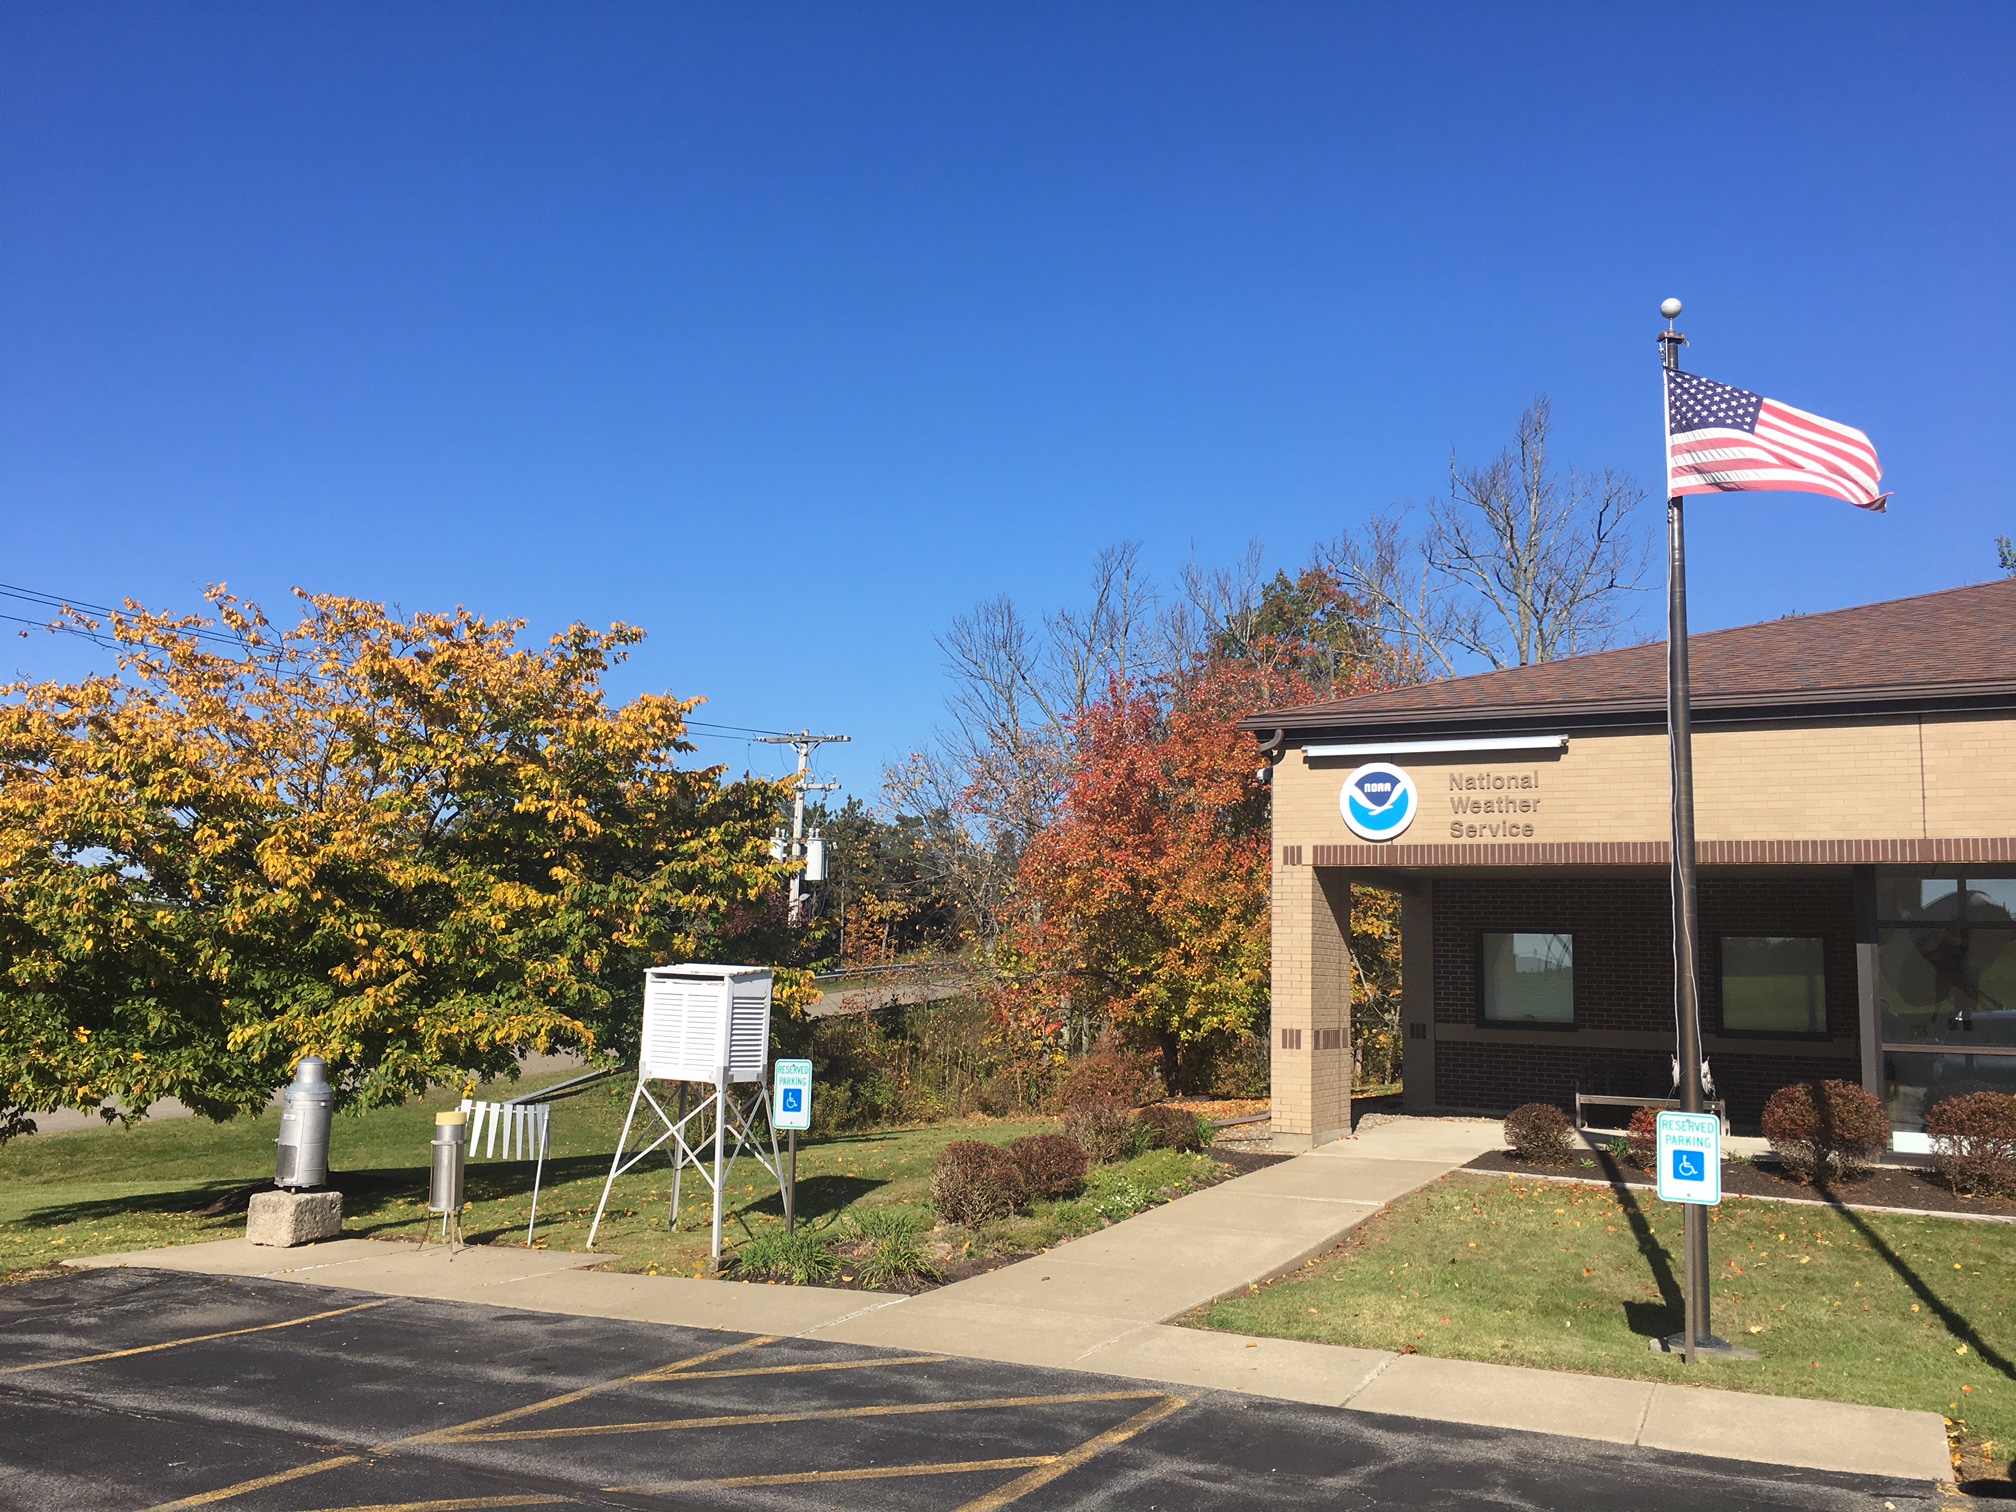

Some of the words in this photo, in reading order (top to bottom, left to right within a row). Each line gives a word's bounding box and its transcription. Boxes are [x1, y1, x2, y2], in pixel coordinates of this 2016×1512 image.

[1449, 770, 1539, 790] National
[1364, 782, 1391, 792] NOAA
[1450, 795, 1541, 814] Weather
[1450, 820, 1534, 838] Service
[778, 1066, 808, 1074] RESERVED
[780, 1077, 806, 1086] PARKING
[1662, 1120, 1714, 1133] RESERVED
[1666, 1135, 1711, 1148] PARKING
